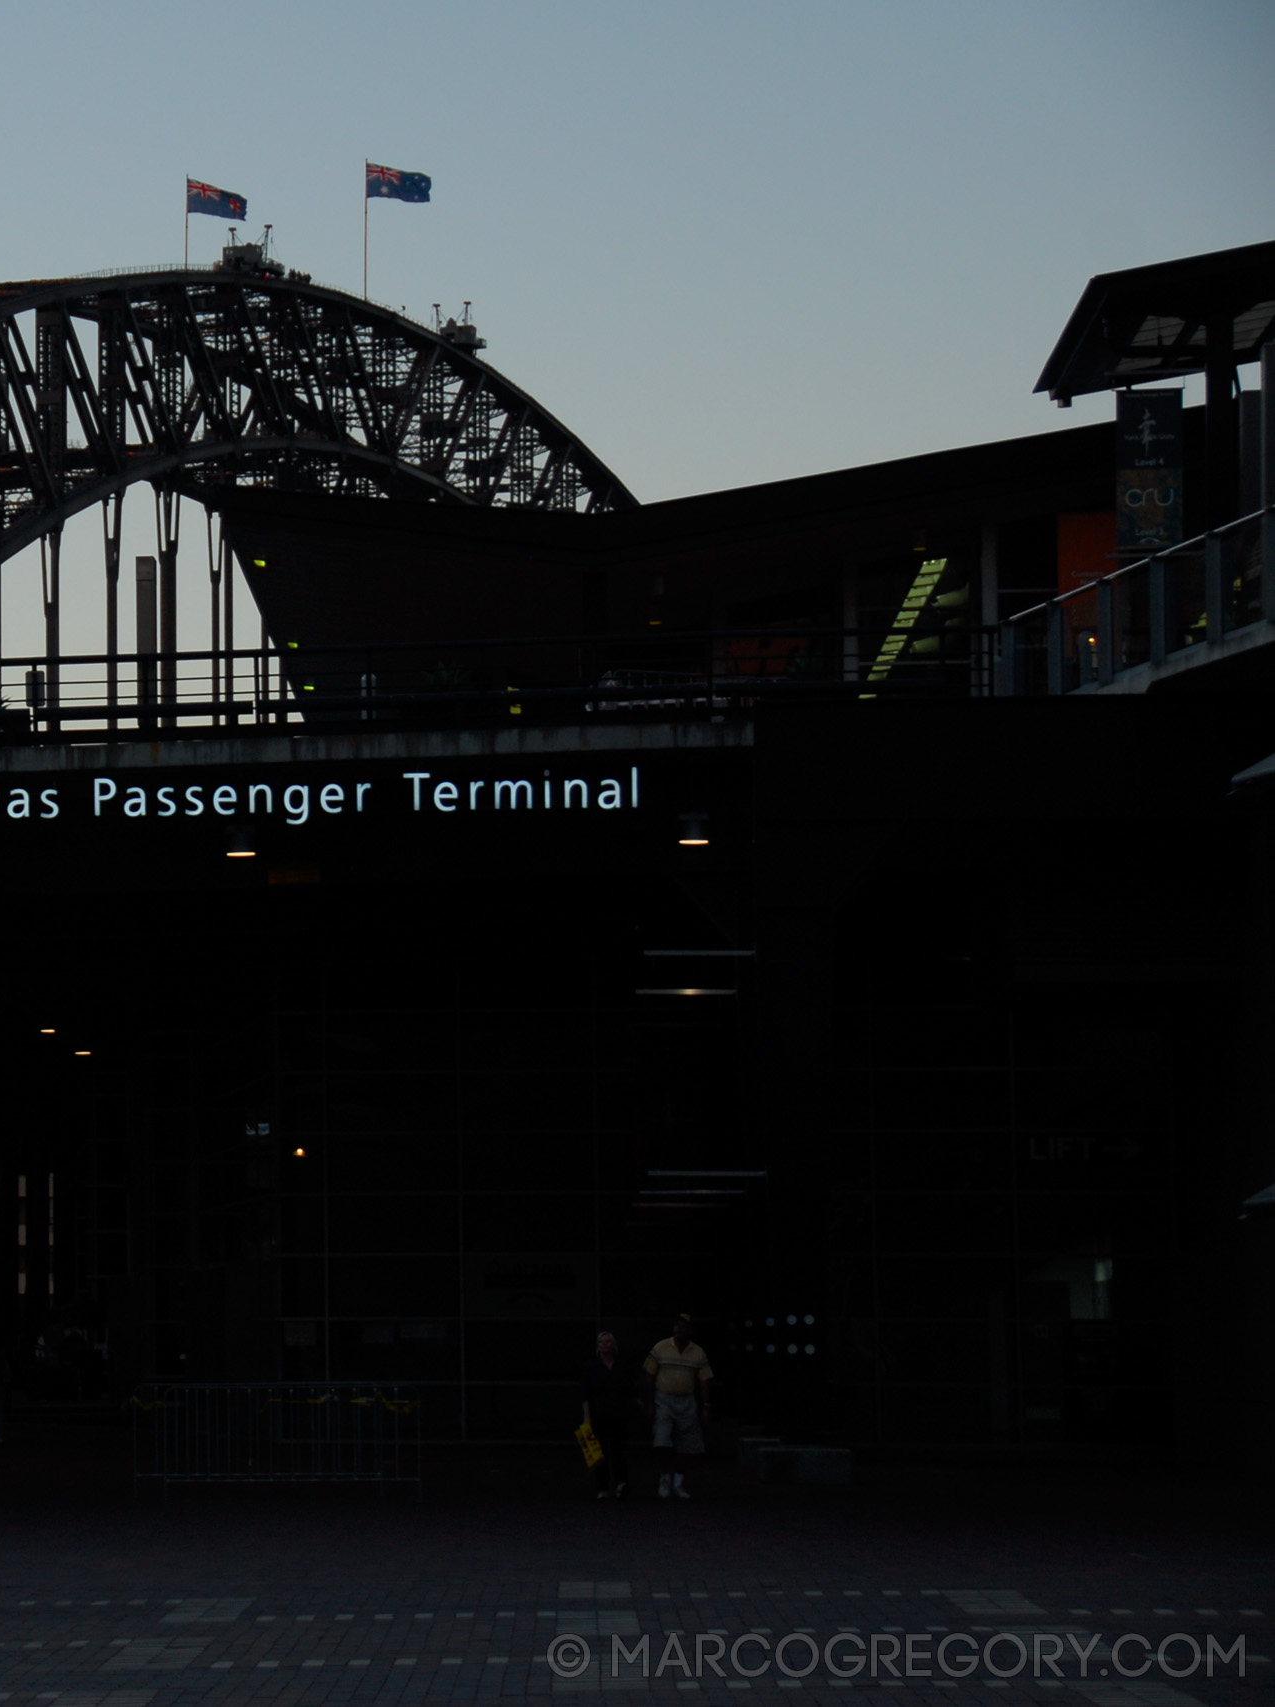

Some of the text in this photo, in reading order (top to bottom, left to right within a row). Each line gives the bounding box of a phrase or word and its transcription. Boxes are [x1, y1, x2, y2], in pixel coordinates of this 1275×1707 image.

[93, 777, 372, 825] Passenger
[402, 766, 639, 812] Terminal
[1028, 1136, 1097, 1160] LIFT
